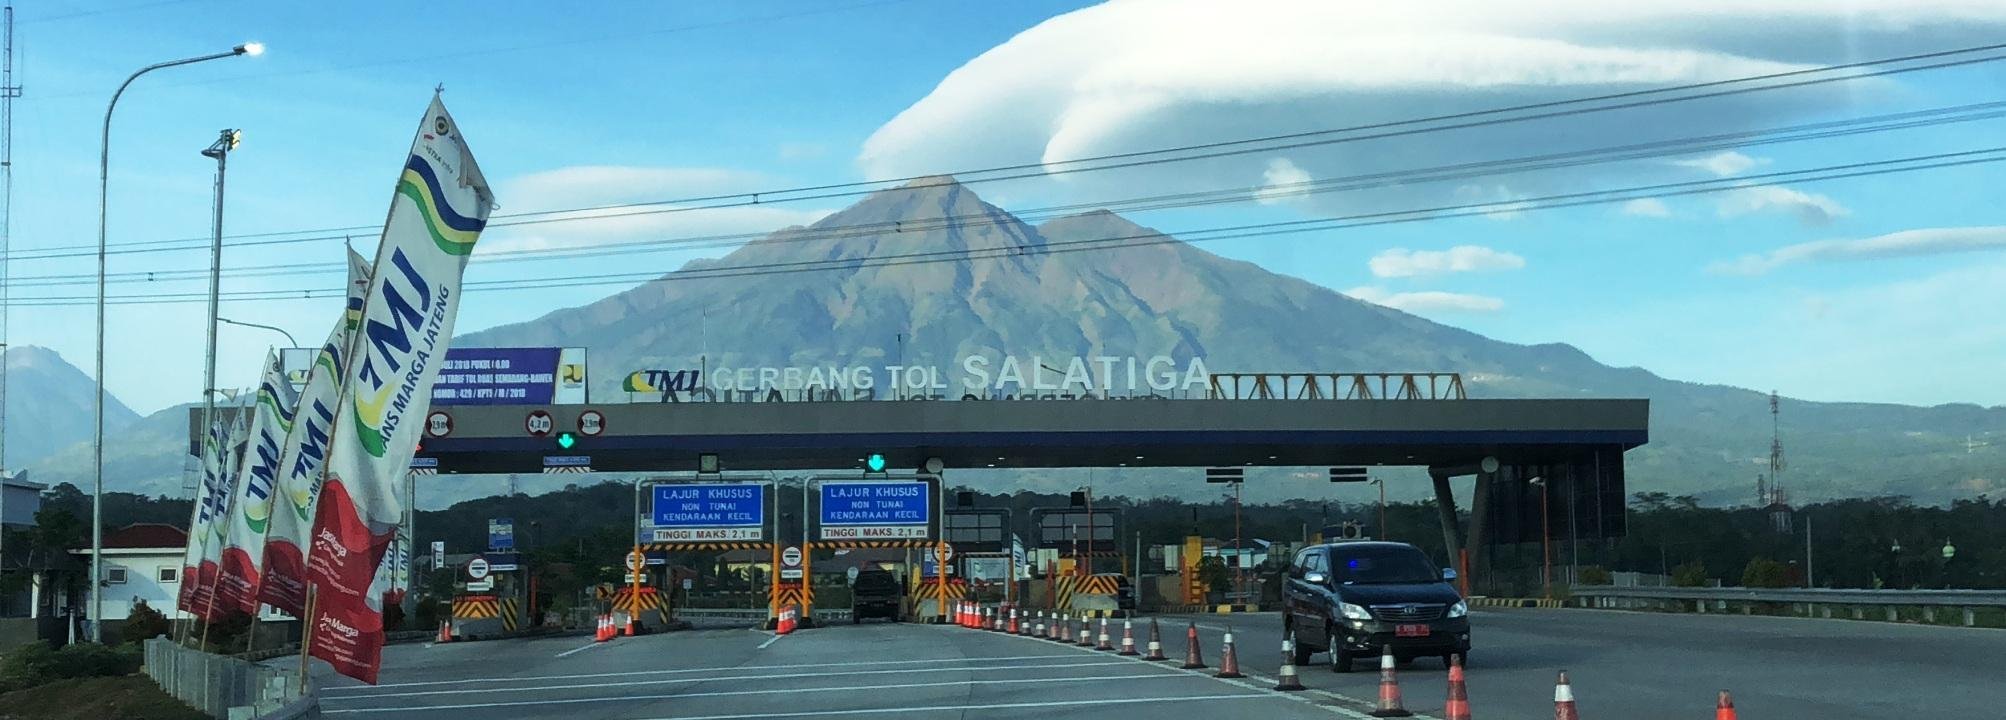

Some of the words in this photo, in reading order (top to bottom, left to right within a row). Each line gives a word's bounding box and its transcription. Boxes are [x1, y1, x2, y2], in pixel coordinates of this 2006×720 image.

[398, 351, 430, 419] MARGA
[424, 283, 450, 353] JATENG
[711, 366, 874, 390] GERBANG
[884, 366, 948, 390] TOL
[962, 354, 1212, 390] SALATIGA
[466, 374, 476, 384] TOL
[639, 370, 700, 392] TMJ
[246, 428, 280, 501] TMJ
[663, 490, 700, 499] LAJUR
[708, 488, 752, 498] KHUSUS
[830, 487, 870, 498] LAJUR
[876, 486, 919, 497] KHUSUS
[682, 502, 700, 511] NON
[709, 502, 736, 511] TUNAI
[852, 501, 870, 509] NON
[876, 500, 904, 509] TUNAI
[664, 513, 720, 521] KENDARAAN
[728, 512, 752, 520] KECIL
[830, 511, 889, 520] KENDARAAN
[894, 510, 920, 519] KECIL
[656, 530, 691, 540] TINGGI
[732, 530, 746, 540] 2,1
[824, 528, 858, 538] TINGGI
[898, 528, 912, 538] 2,1
[331, 617, 360, 639] Marga
